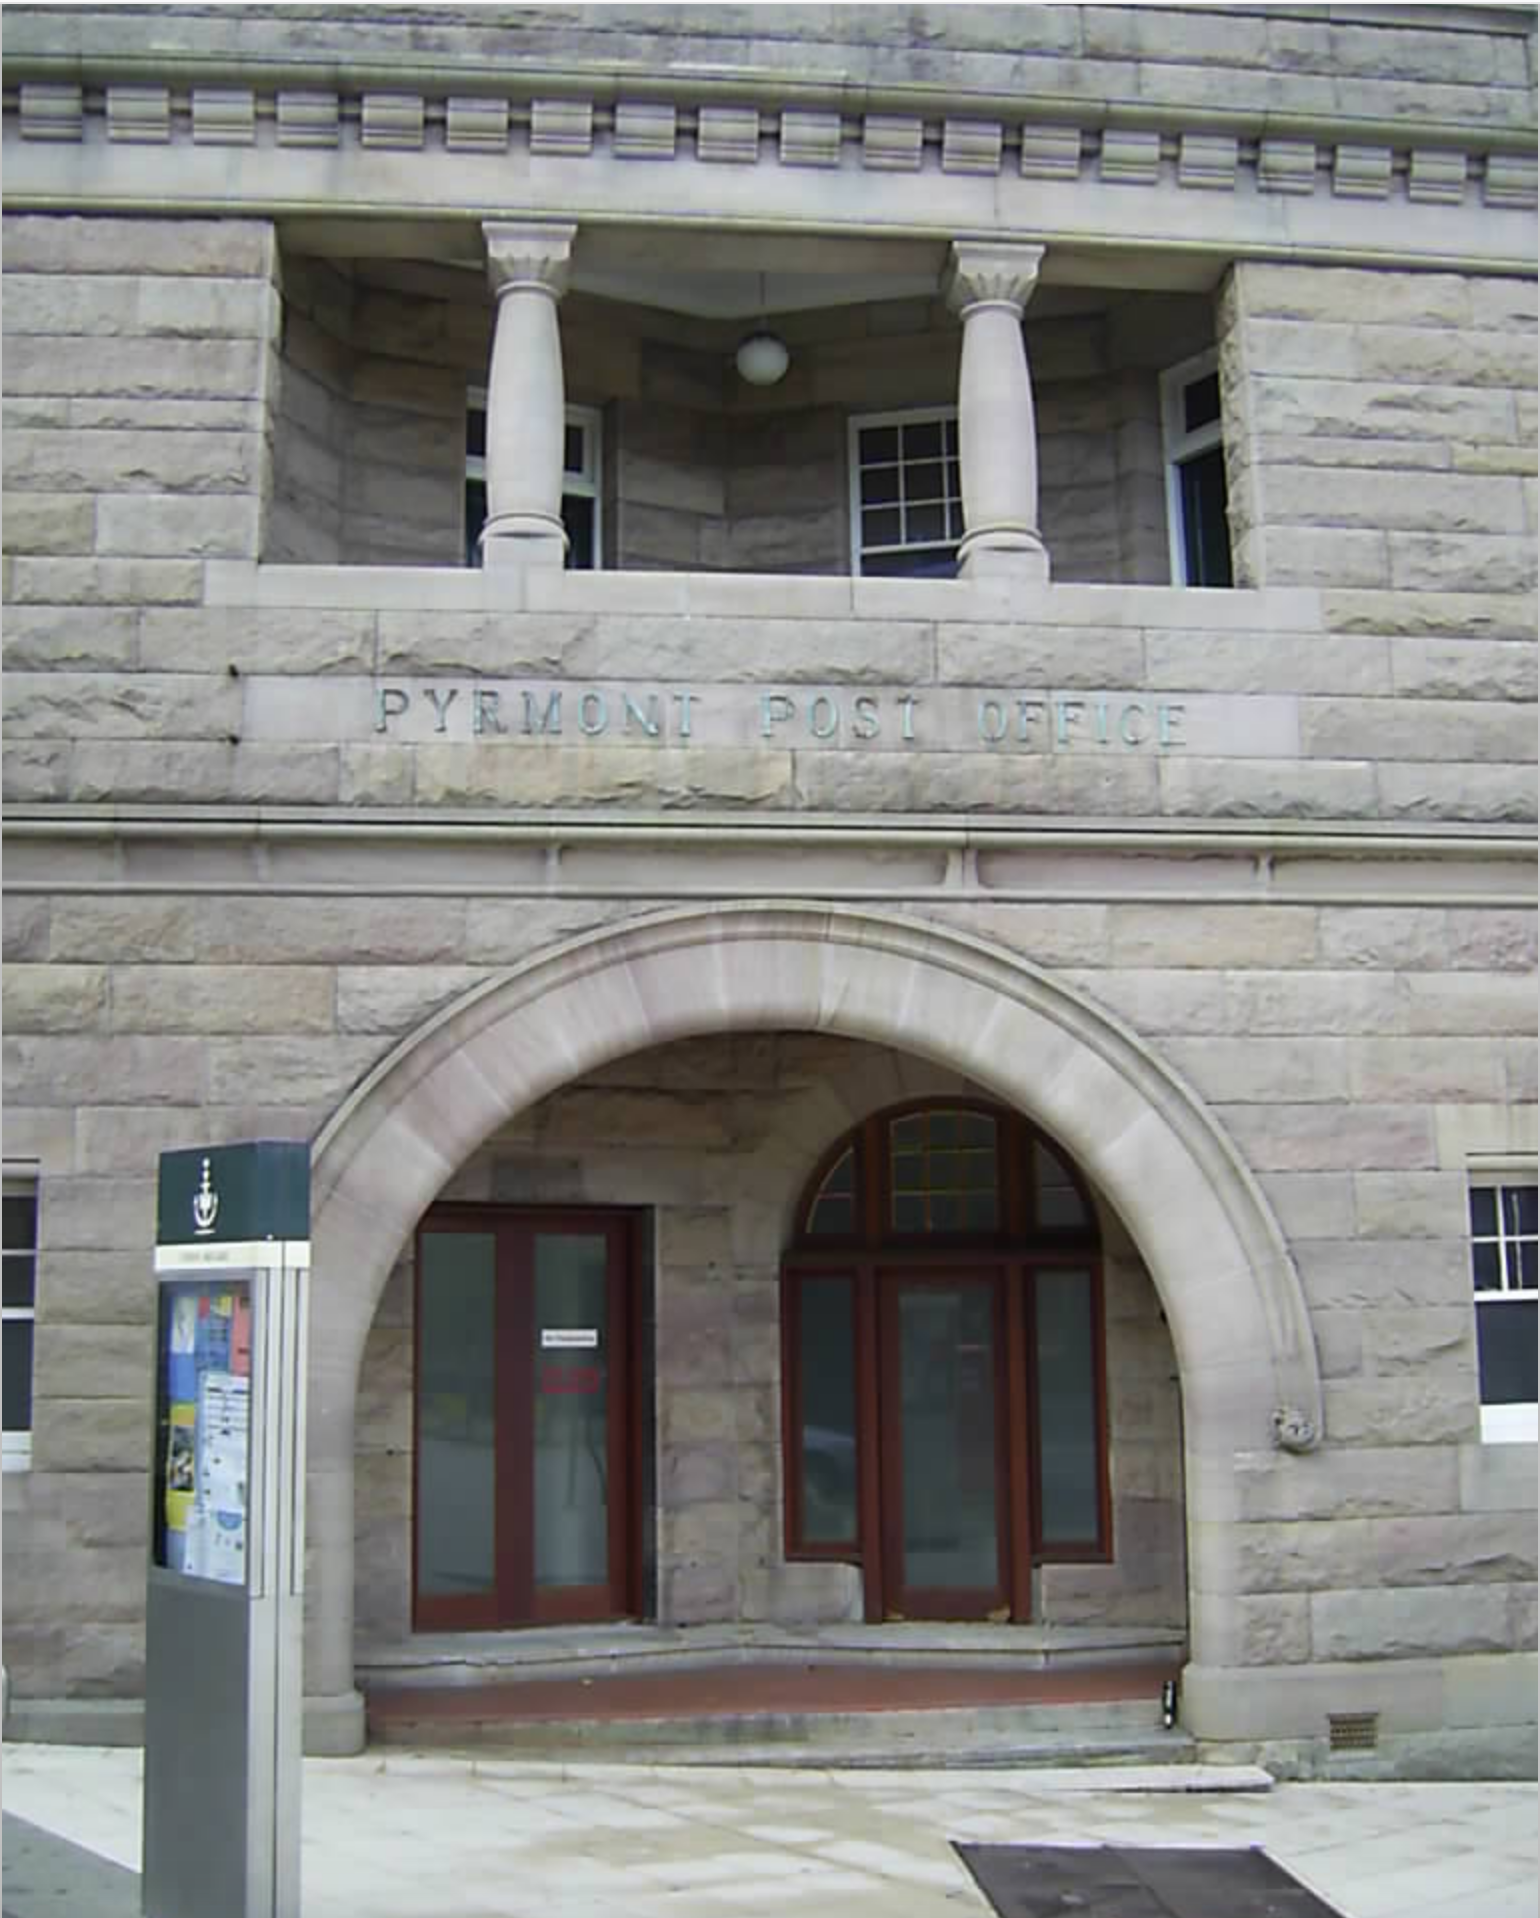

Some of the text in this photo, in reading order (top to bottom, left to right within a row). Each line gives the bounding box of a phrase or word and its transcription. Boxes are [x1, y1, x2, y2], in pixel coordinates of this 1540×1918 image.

[373, 688, 1187, 747] PYRMONT POST OFFICE
